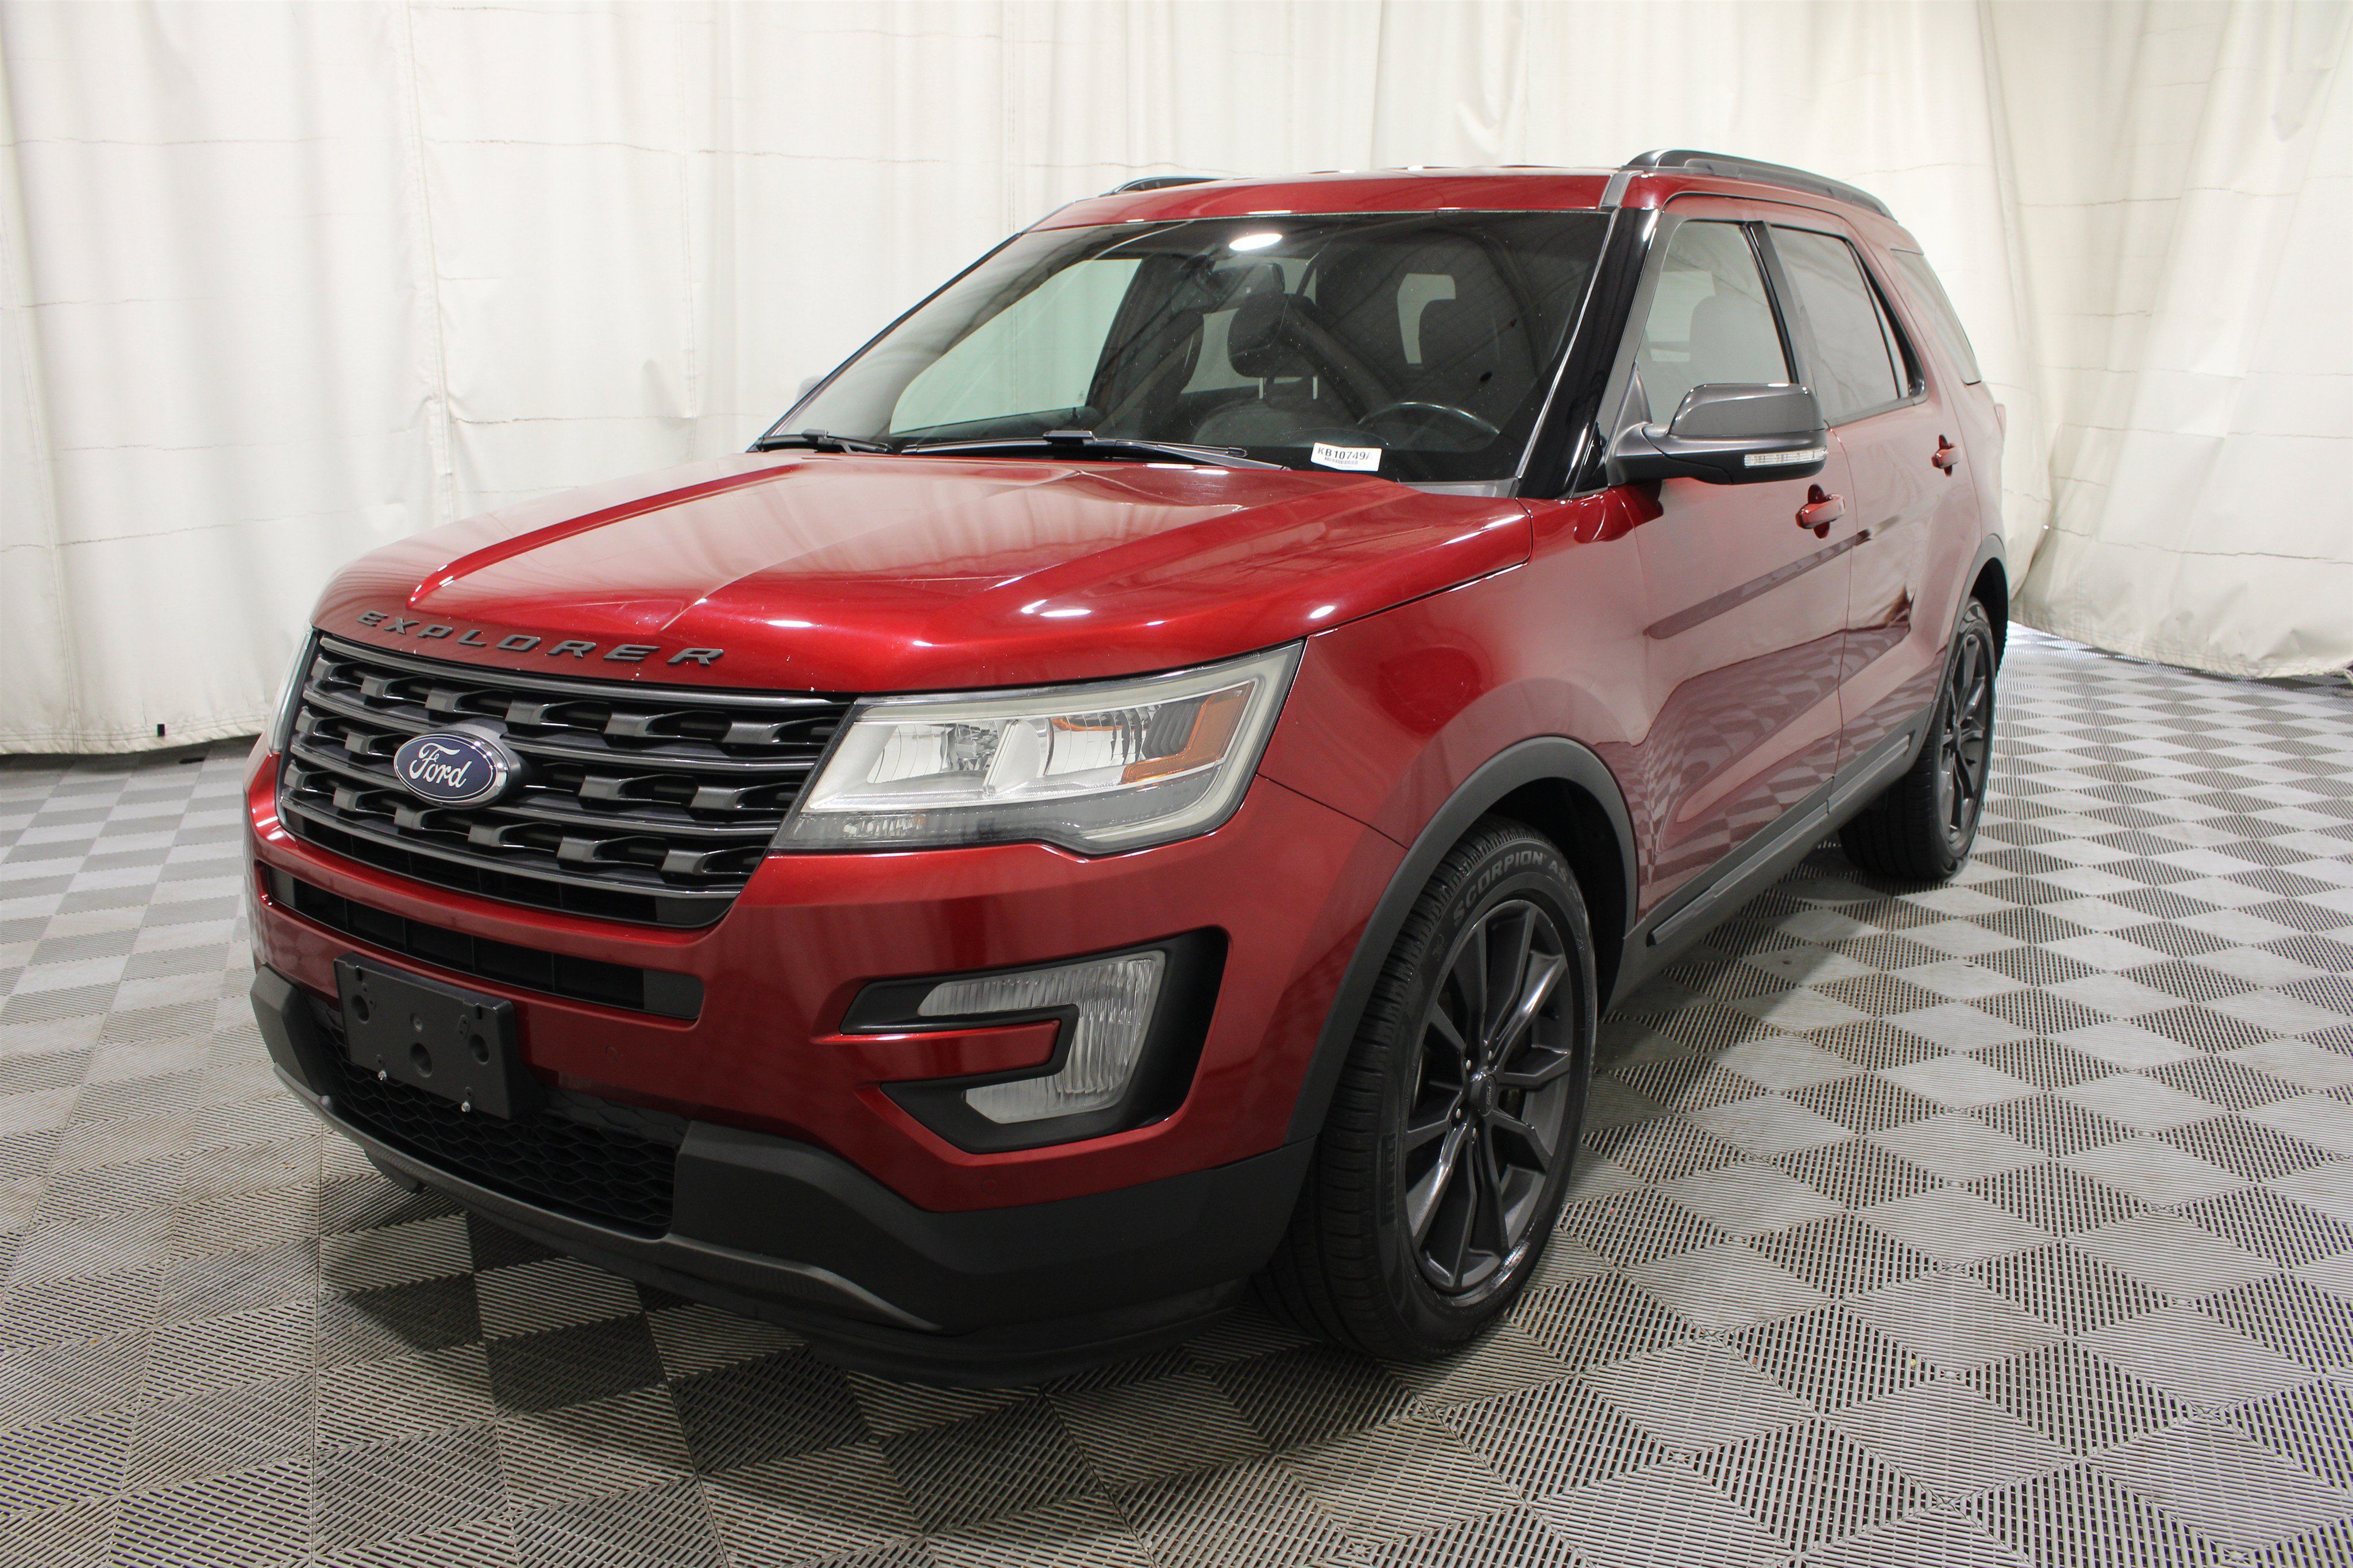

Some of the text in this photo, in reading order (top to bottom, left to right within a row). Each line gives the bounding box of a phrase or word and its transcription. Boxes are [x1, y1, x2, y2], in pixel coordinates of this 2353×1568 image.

[356, 609, 725, 666] EXPLORER
[409, 742, 473, 789] Ford
[1453, 850, 1545, 928] SCORPION
